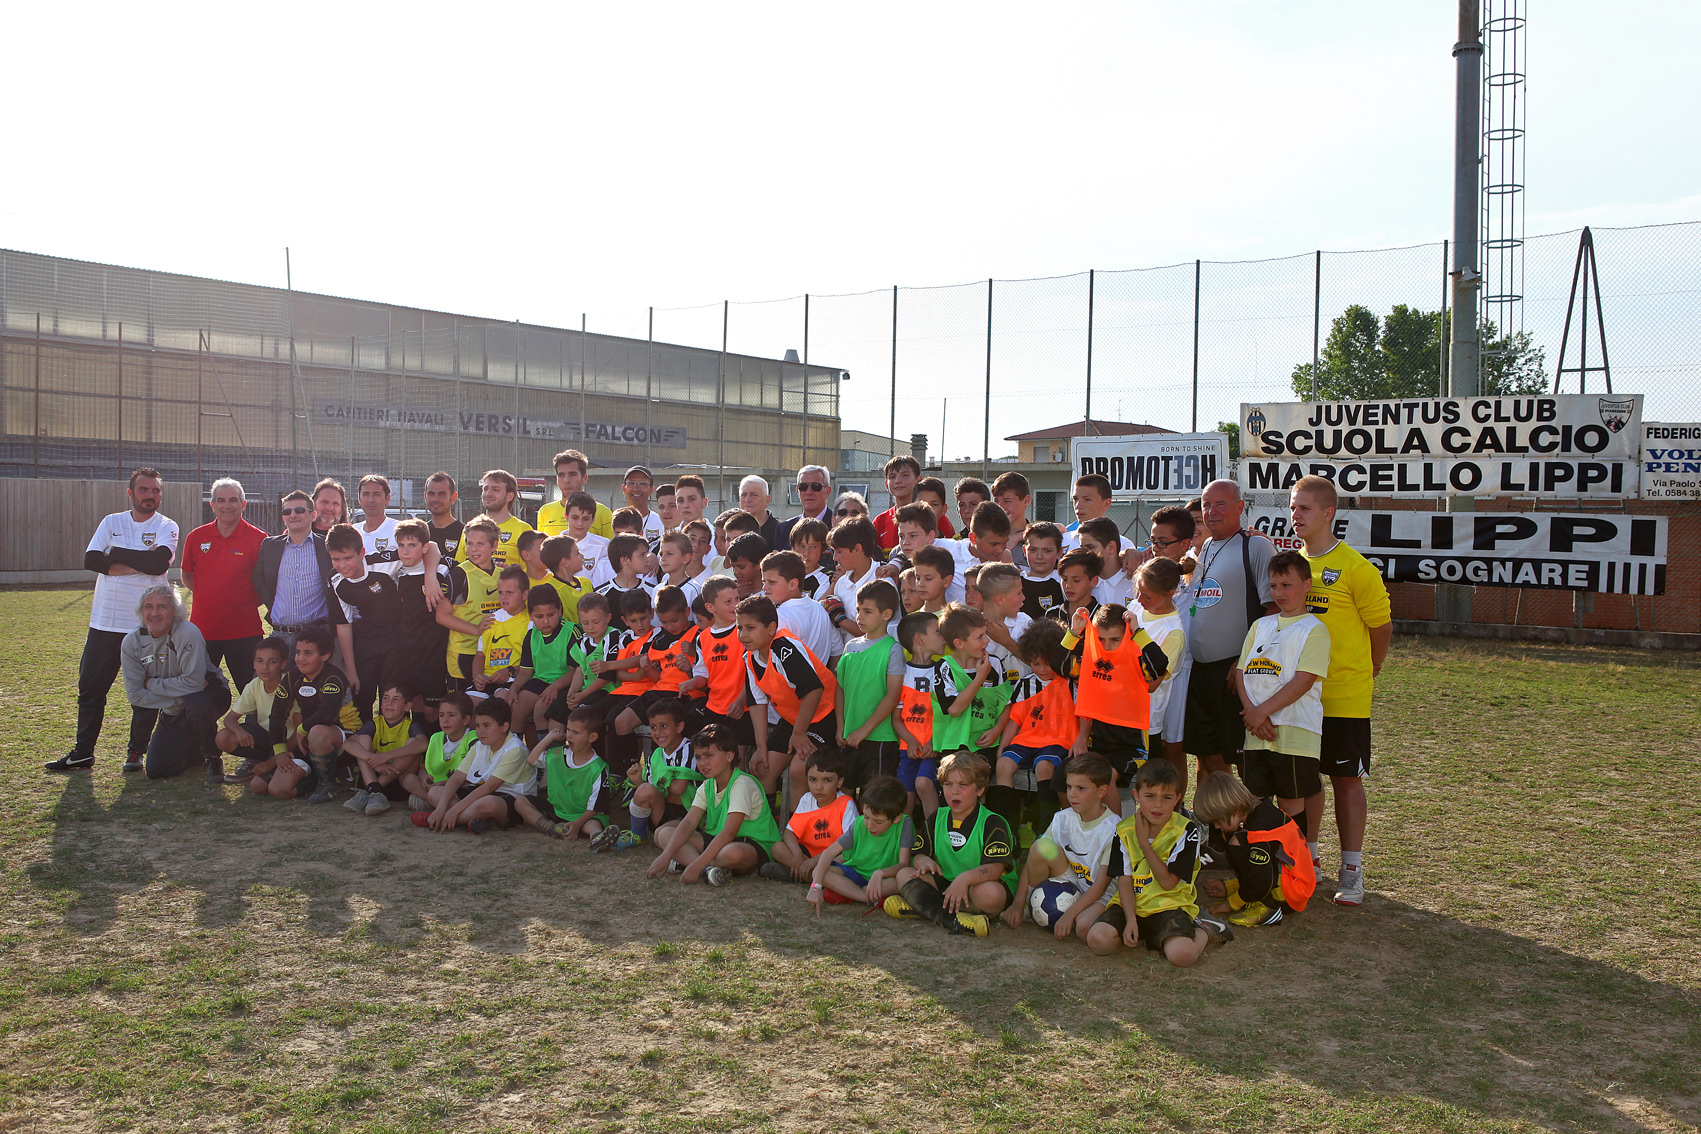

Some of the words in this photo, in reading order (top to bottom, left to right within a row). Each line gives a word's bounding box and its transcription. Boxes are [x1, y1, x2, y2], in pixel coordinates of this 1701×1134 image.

[325, 405, 389, 422] CANTIERI
[1308, 400, 1460, 427] JUVENTUS
[1472, 399, 1557, 423] CLUB
[584, 423, 661, 444] FALCON
[1260, 427, 1430, 455] SCUOLA
[1441, 424, 1609, 454] CALCIO
[1646, 449, 1701, 460] VOL
[1249, 462, 1482, 493] MARCELLO
[1501, 462, 1623, 494] LIPPI
[1670, 480, 1696, 488] Paolo
[1646, 489, 1663, 497] Tel.
[1665, 489, 1687, 497] 0584
[1371, 513, 1657, 557] LIPPI
[1418, 558, 1590, 588] SOGNARE
[491, 648, 513, 660] SKY
[914, 676, 930, 692] B
[1092, 670, 1112, 682] errea
[906, 716, 924, 724] errea
[814, 831, 831, 840] errea
